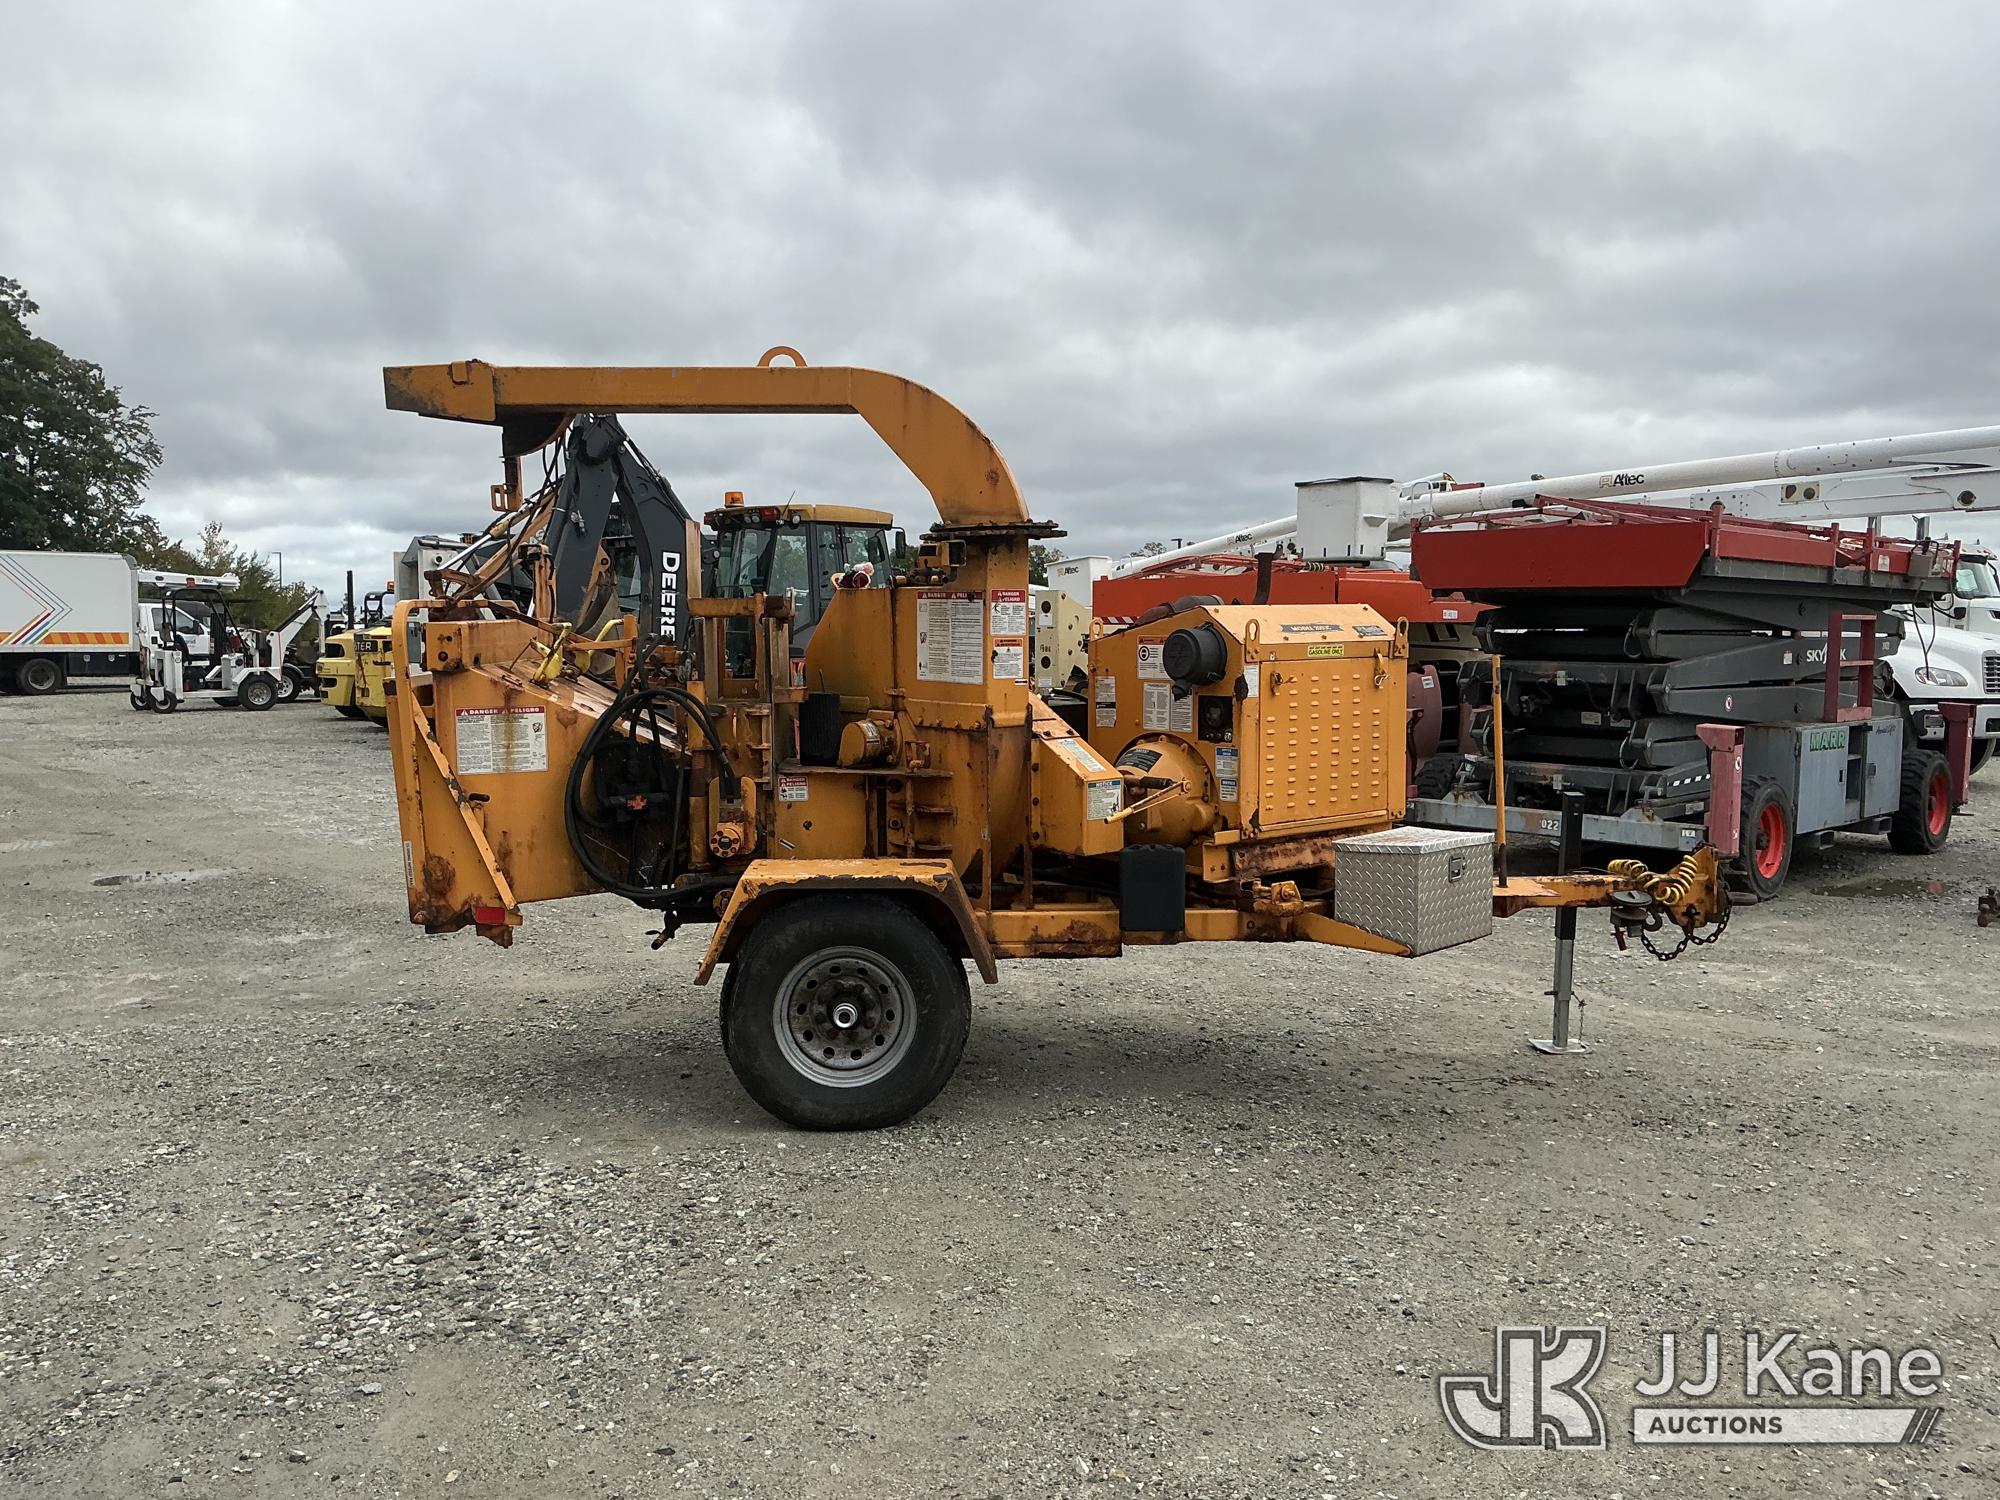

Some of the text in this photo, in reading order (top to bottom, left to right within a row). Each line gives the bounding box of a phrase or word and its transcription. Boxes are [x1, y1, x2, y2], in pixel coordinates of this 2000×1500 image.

[1613, 473, 1645, 487] Altec
[660, 551, 681, 641] DEERE
[1806, 643, 1847, 665] SKYJK
[1809, 730, 1846, 752] MARR
